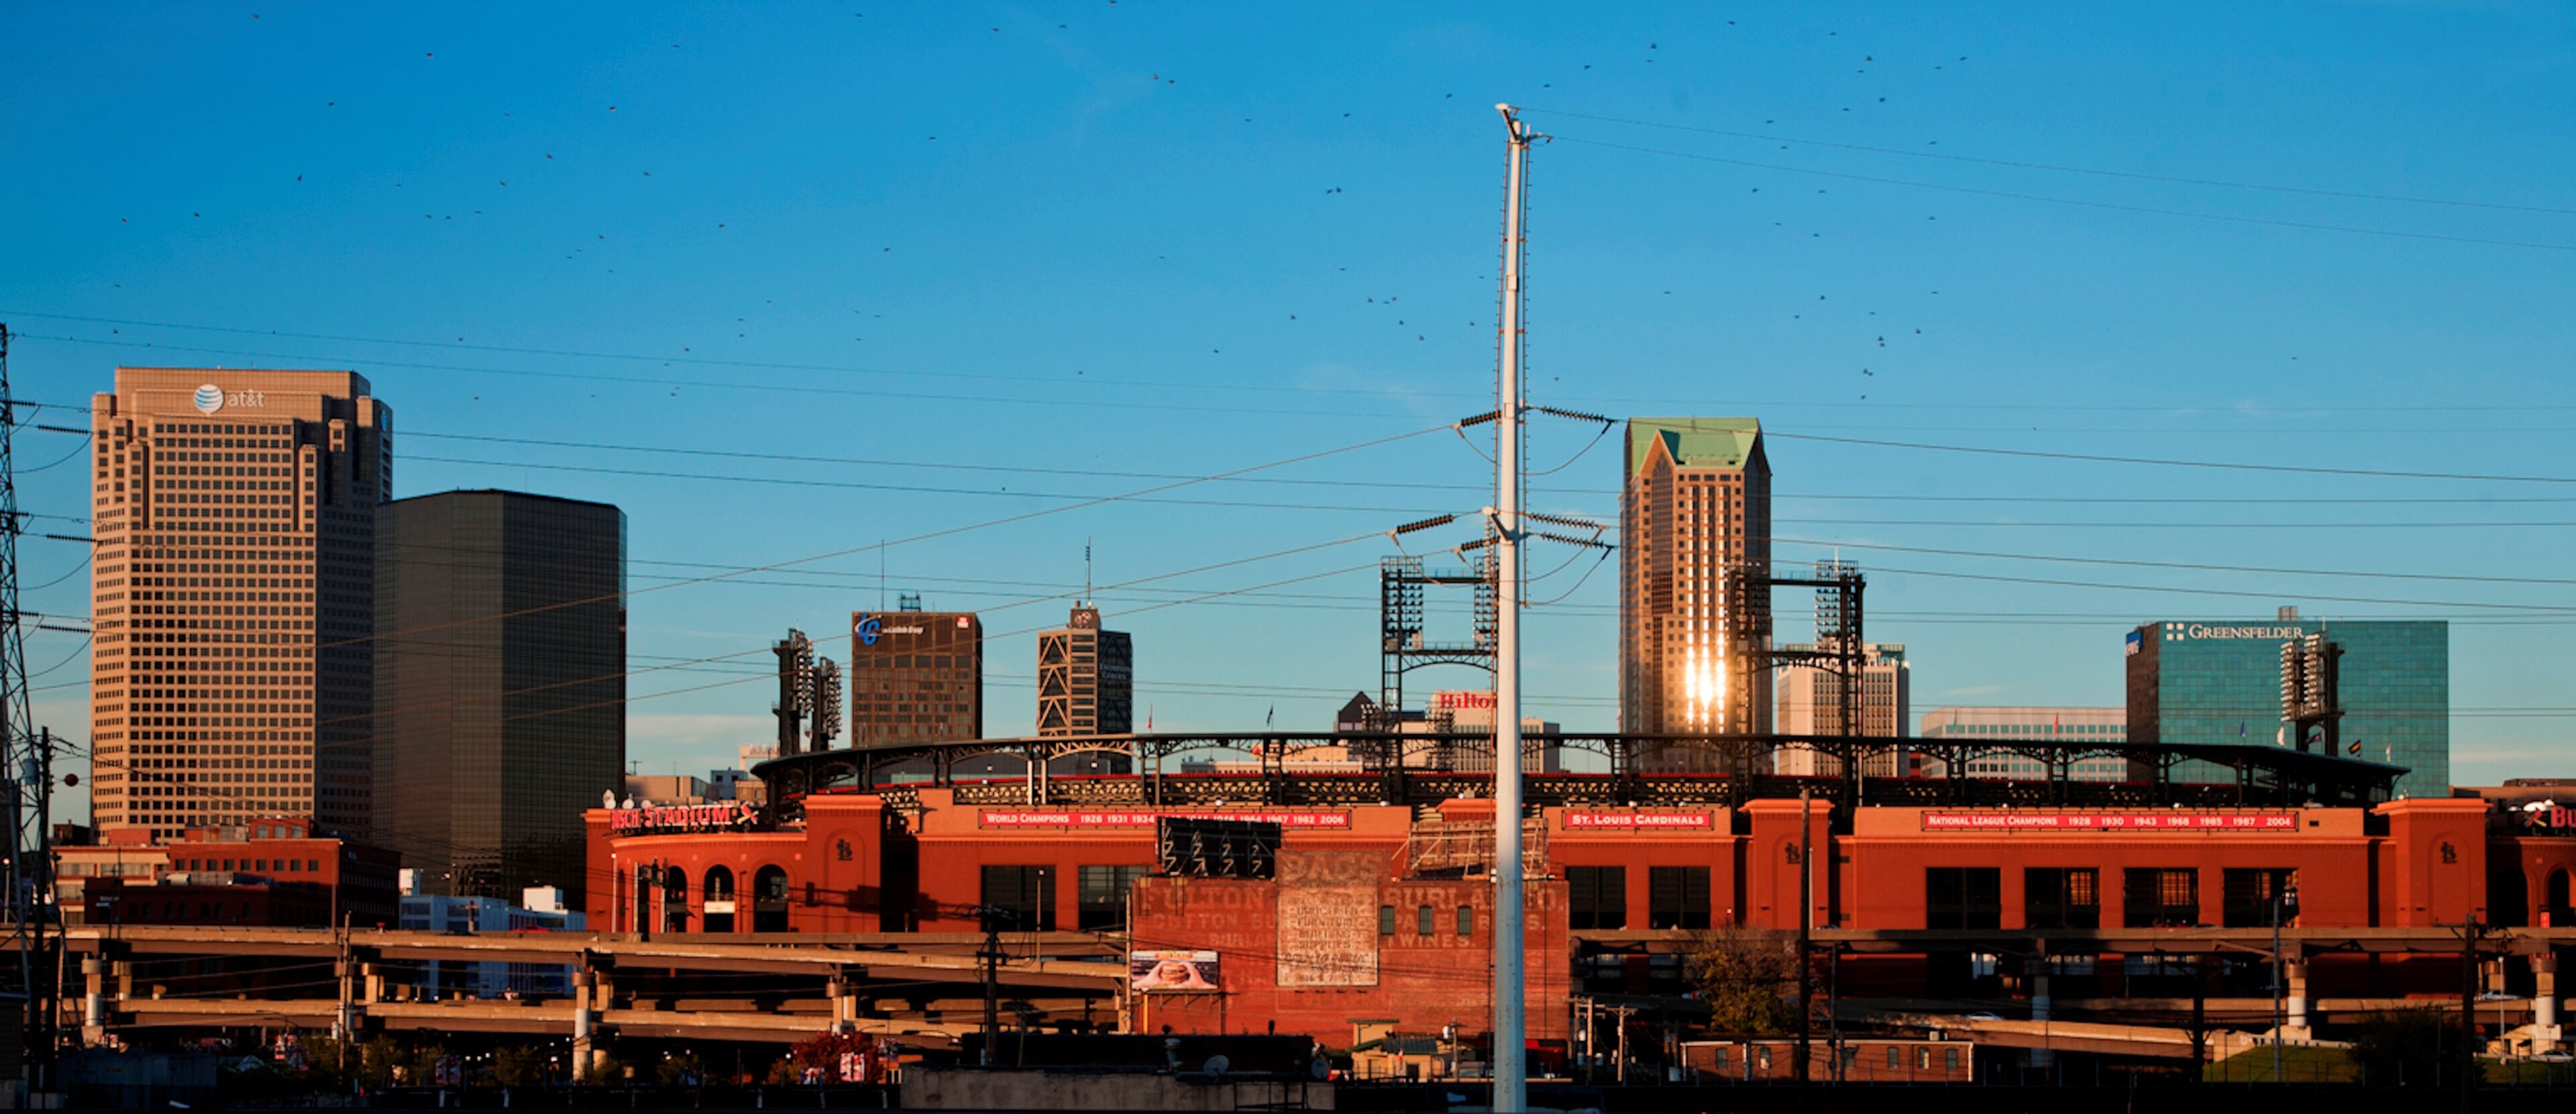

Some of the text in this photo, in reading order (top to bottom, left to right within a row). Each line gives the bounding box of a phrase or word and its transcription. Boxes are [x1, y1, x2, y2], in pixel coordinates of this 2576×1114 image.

[227, 389, 264, 407] at&t
[2188, 623, 2304, 640] GREENSFELDER
[644, 805, 733, 827] STADIUM
[987, 813, 1017, 823] WORLD
[1020, 813, 1069, 823] CHAMPIONS
[1080, 815, 1102, 823] 1926
[1107, 815, 1128, 823] 1931
[1132, 815, 1155, 823] 1934
[1293, 815, 1315, 823] 1982
[1320, 815, 1344, 823] 2006
[1635, 815, 1703, 824] CARDINALS
[1929, 816, 2290, 826] NATIONAL LEAGUE CHAMPIONS 1928 1930 1943 1968 1985 1987 2004
